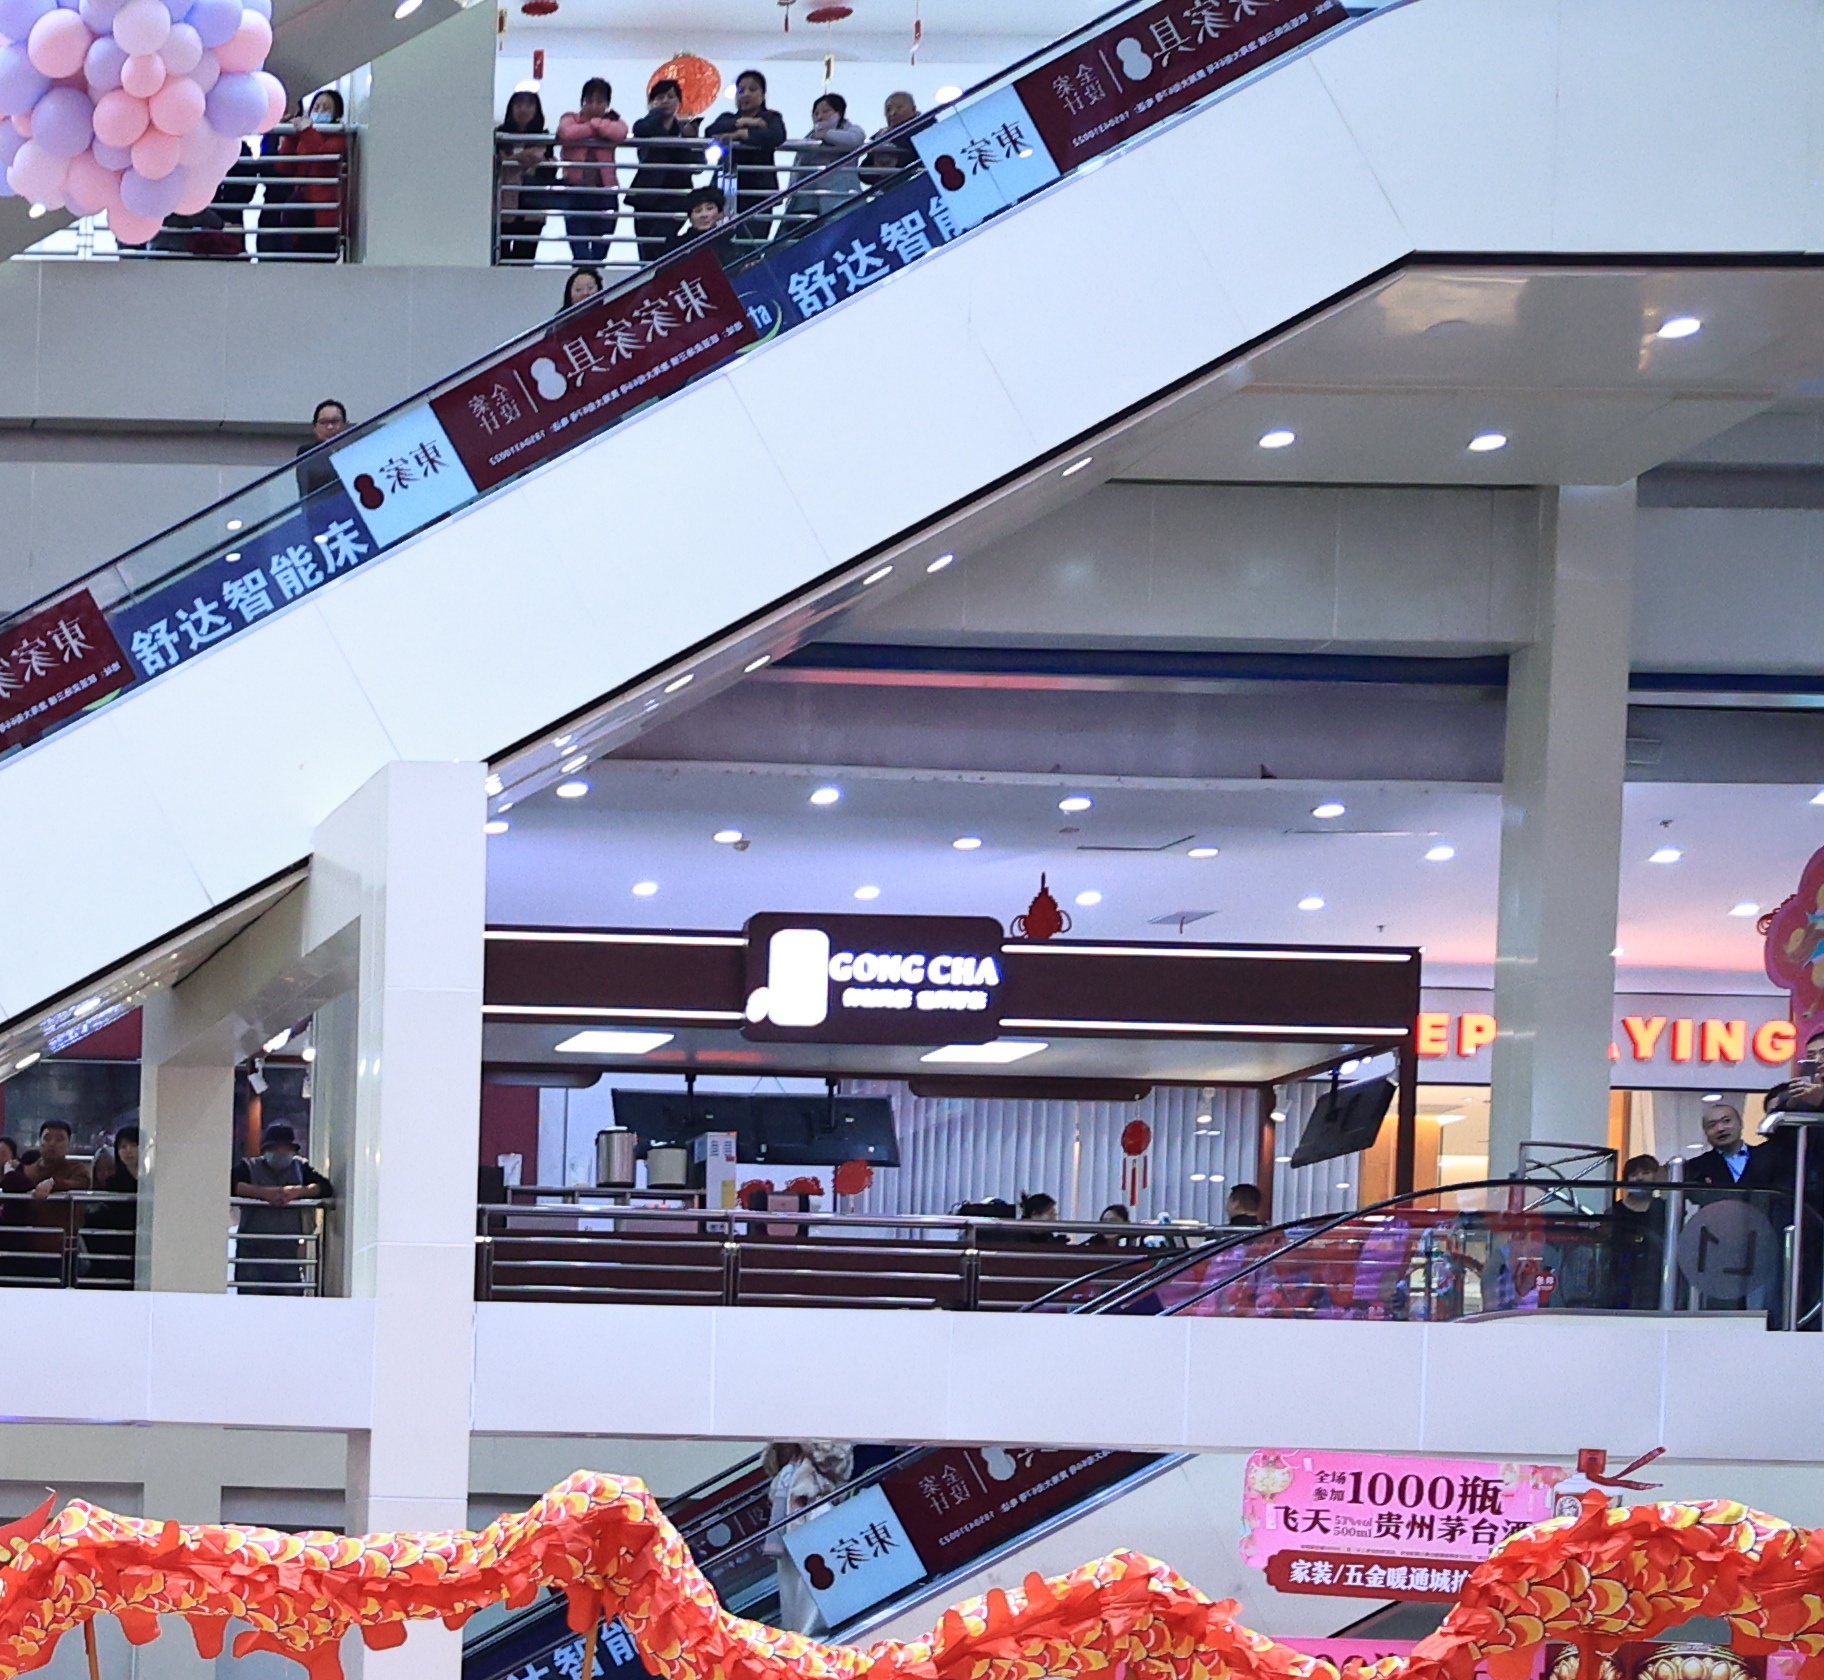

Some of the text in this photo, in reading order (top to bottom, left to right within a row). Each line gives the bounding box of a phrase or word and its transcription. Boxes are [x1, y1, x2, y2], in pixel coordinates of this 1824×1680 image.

[130, 517, 368, 664] 舒达智能床
[829, 952, 1000, 986] GONG CHA
[1608, 1015, 1797, 1063] YING
[1313, 1487, 1345, 1502] 参加
[1315, 1470, 1504, 1517] 全场 1000瓶
[1274, 1505, 1332, 1535] 飞天
[1333, 1527, 1373, 1539] 500ml
